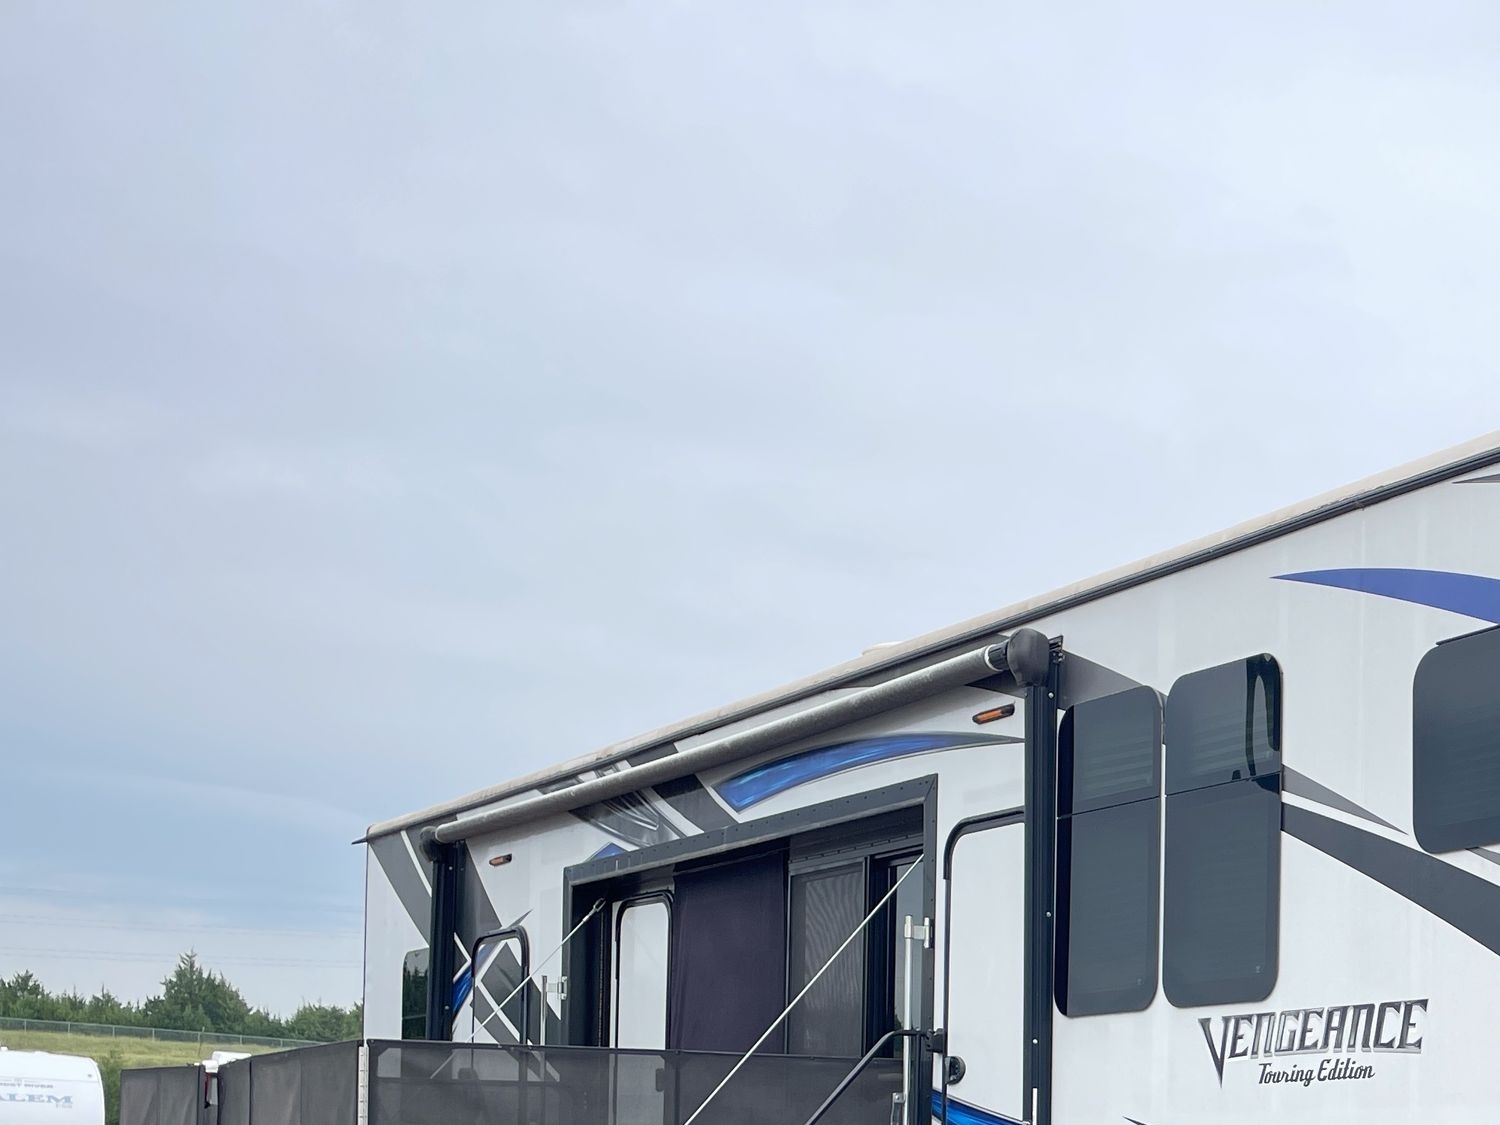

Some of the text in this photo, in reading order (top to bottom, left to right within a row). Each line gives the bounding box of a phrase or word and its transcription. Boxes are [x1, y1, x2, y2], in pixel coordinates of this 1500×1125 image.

[1198, 998, 1429, 1088] VENGEANCE
[1258, 1057, 1376, 1087] Touring Edition
